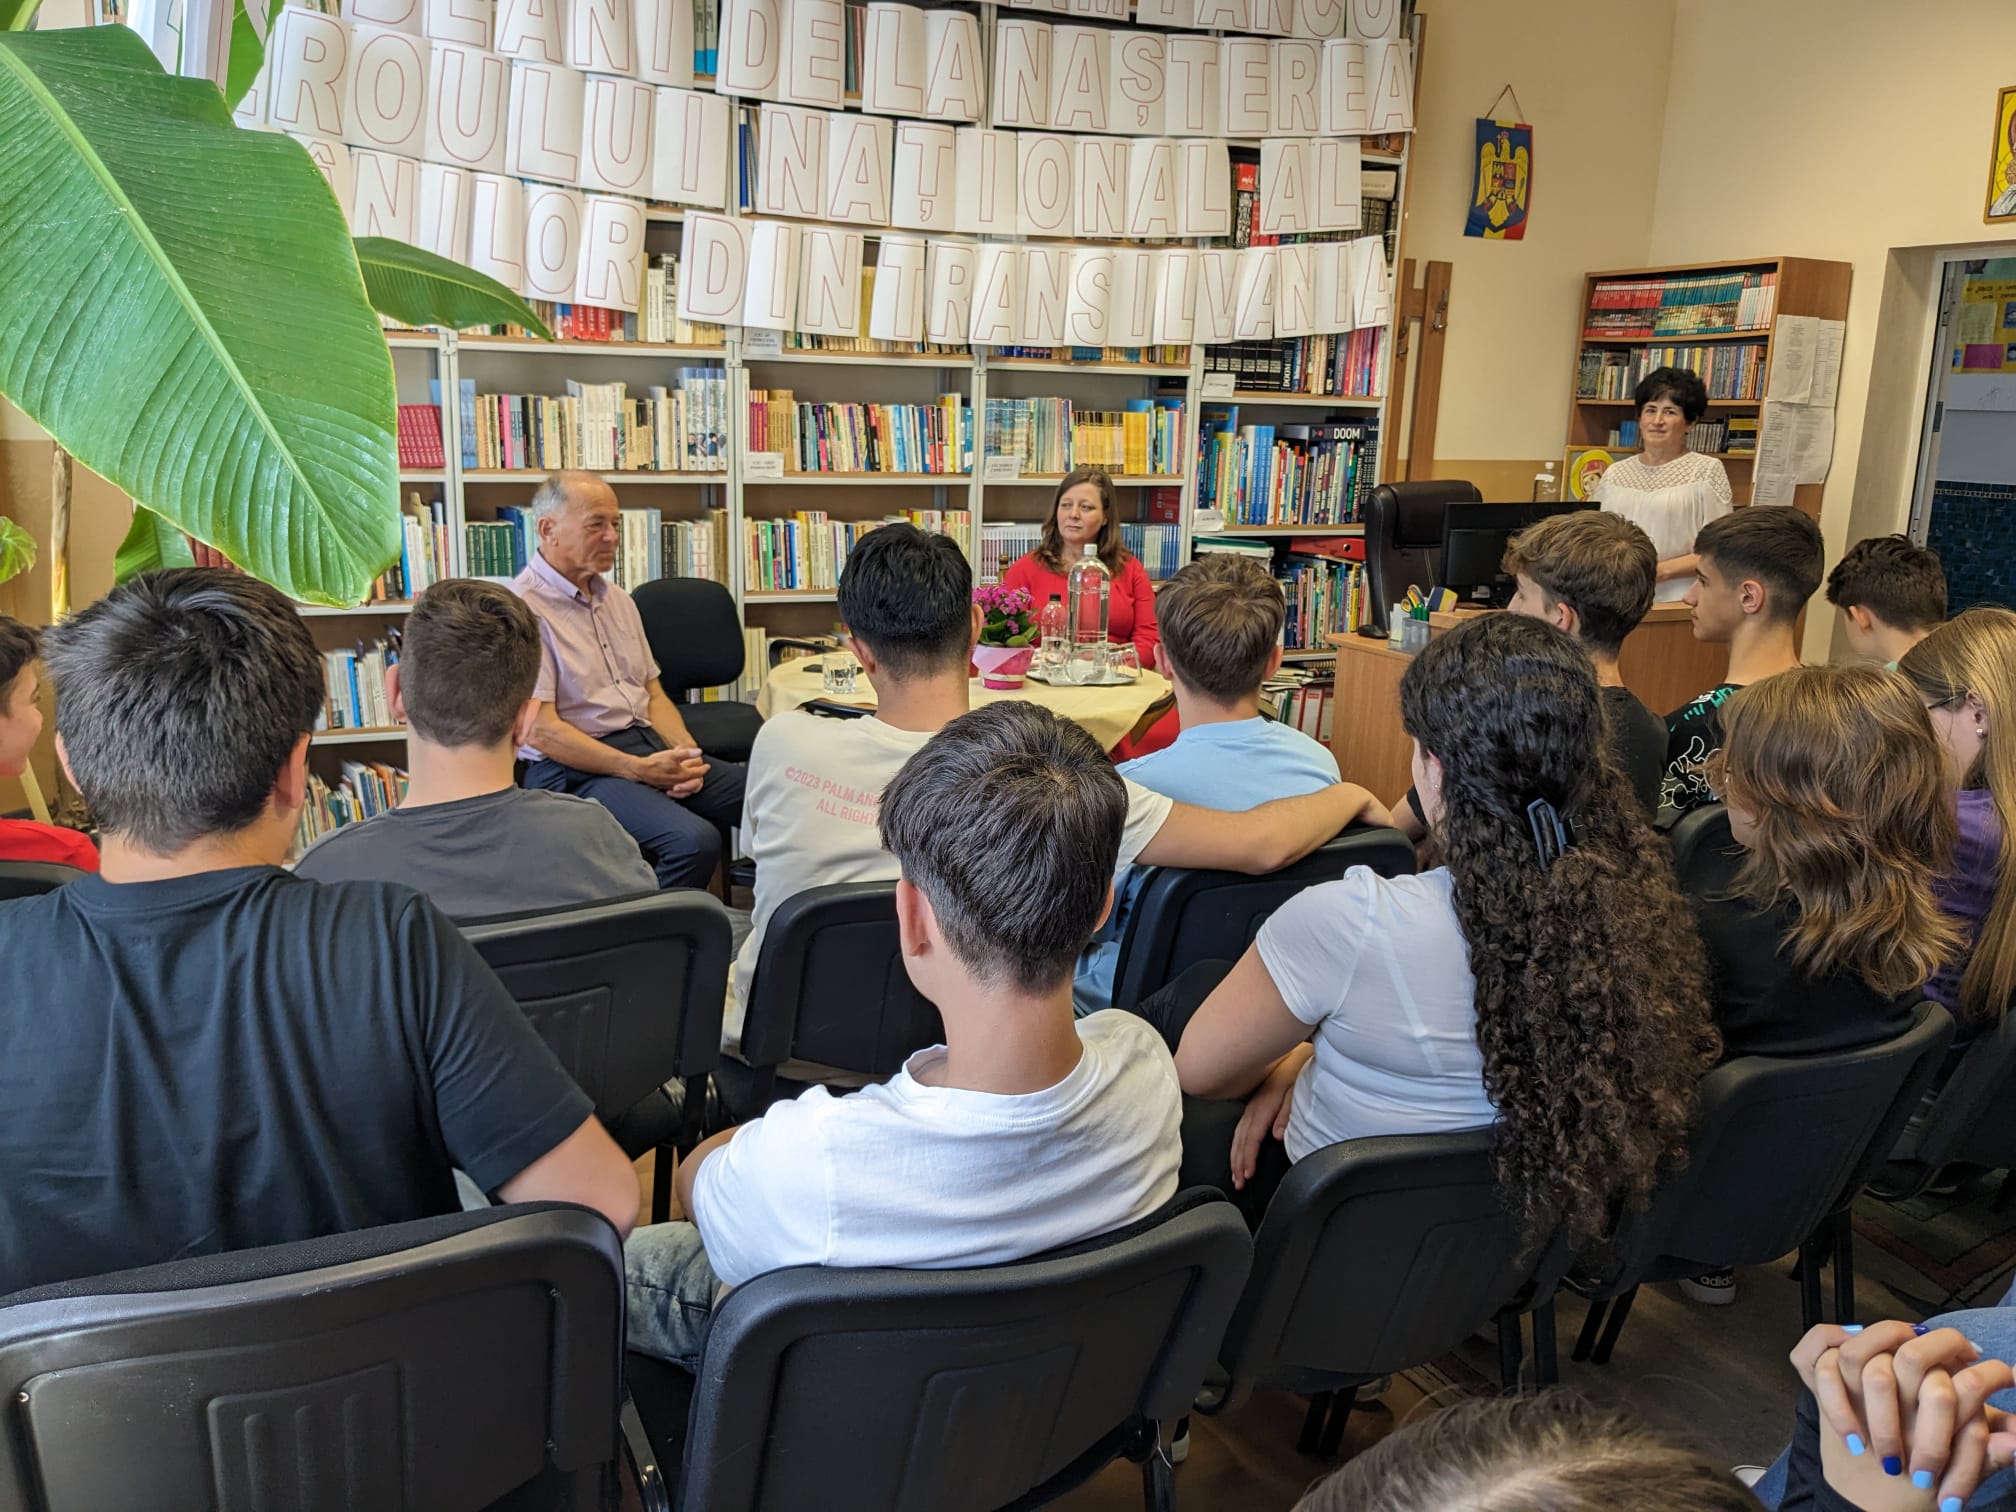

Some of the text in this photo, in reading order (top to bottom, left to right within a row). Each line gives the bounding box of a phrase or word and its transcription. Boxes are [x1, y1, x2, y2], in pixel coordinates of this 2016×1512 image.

[725, 0, 842, 104] DE
[872, 9, 981, 119] LA
[1001, 25, 1414, 133] NAȘTEREA
[236, 9, 703, 193] ROULUI
[766, 110, 1228, 235] NAȚIONAL
[1262, 142, 1359, 231] AL
[686, 214, 859, 330] DIN
[881, 239, 1391, 346] TRANSILVANIA
[1333, 427, 1361, 440] DOOM
[816, 799, 837, 816] ALL
[822, 780, 855, 802] PALM
